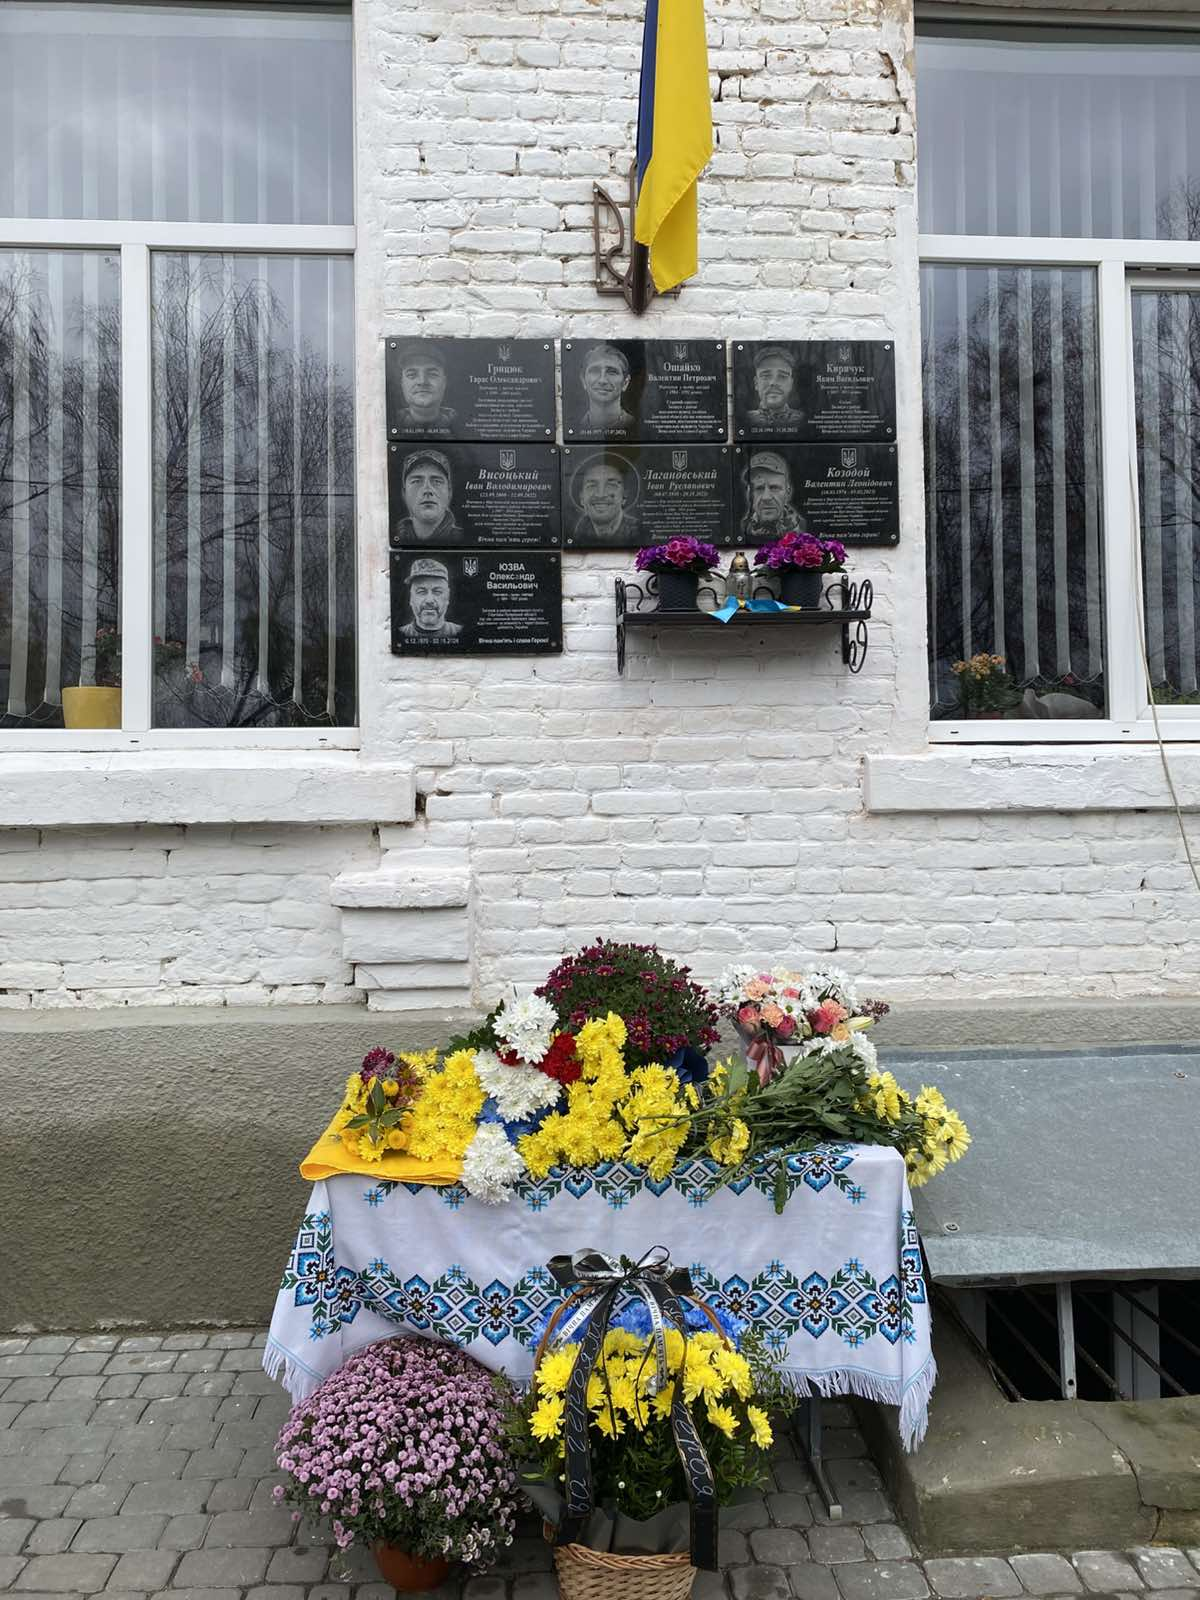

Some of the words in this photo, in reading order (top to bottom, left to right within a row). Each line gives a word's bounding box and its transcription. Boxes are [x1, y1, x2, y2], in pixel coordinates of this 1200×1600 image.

[664, 362, 701, 372] Ошайко
[469, 375, 489, 384] Тарас
[478, 468, 538, 481] Висоцький
[643, 469, 718, 480] Лагановський
[827, 467, 870, 478] Козодой
[465, 481, 483, 490] Іван
[486, 481, 551, 491] Володимирович
[647, 481, 664, 490] Іван
[804, 480, 846, 488] Валентин
[847, 479, 893, 487] Леонідович
[499, 563, 525, 571] ЮЗВА
[489, 572, 536, 582] Олександр
[487, 581, 538, 590] Васильович
[650, 1301, 660, 1326] ВІЧНА
[562, 1316, 582, 1337] ВІЧНА
